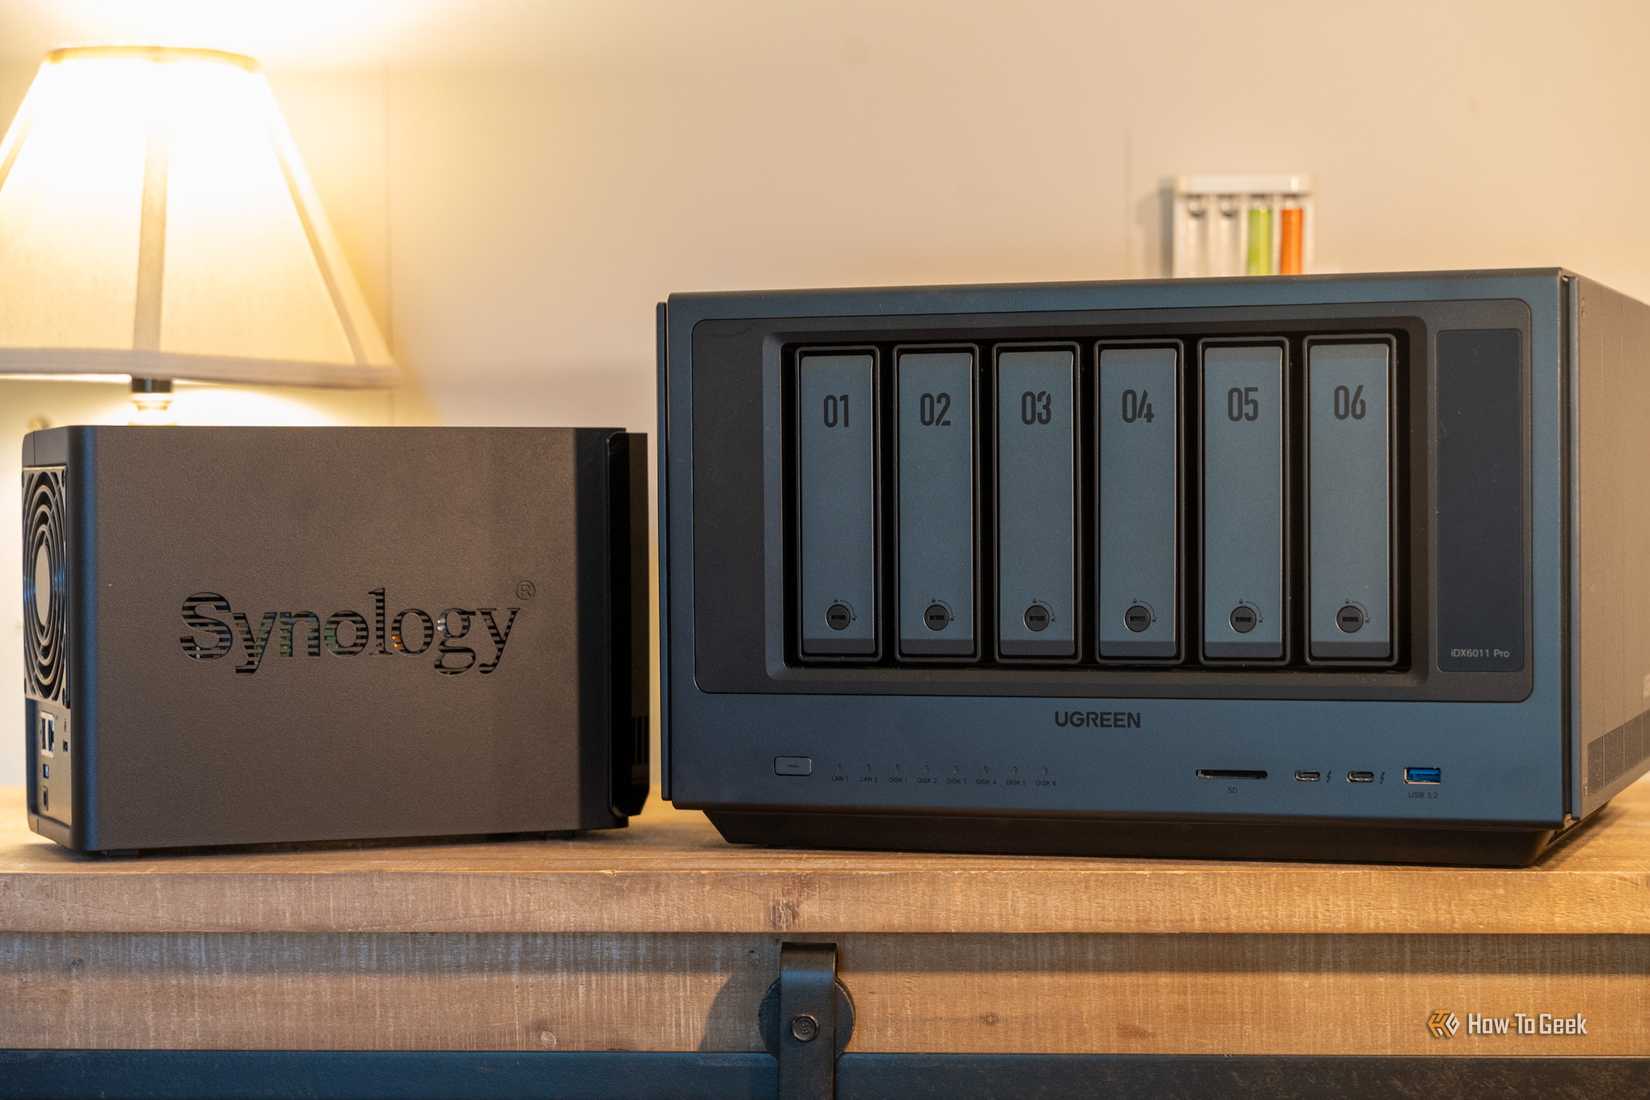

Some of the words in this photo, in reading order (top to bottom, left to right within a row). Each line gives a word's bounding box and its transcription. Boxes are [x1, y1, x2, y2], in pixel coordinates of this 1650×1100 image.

[823, 394, 850, 428] 01
[919, 392, 951, 426] 02
[1021, 390, 1052, 425] 03
[1121, 389, 1155, 423] 04
[1227, 387, 1259, 422] 05
[1333, 385, 1367, 420] 06
[1493, 648, 1511, 658] Pro
[1055, 711, 1142, 729] UGREEN
